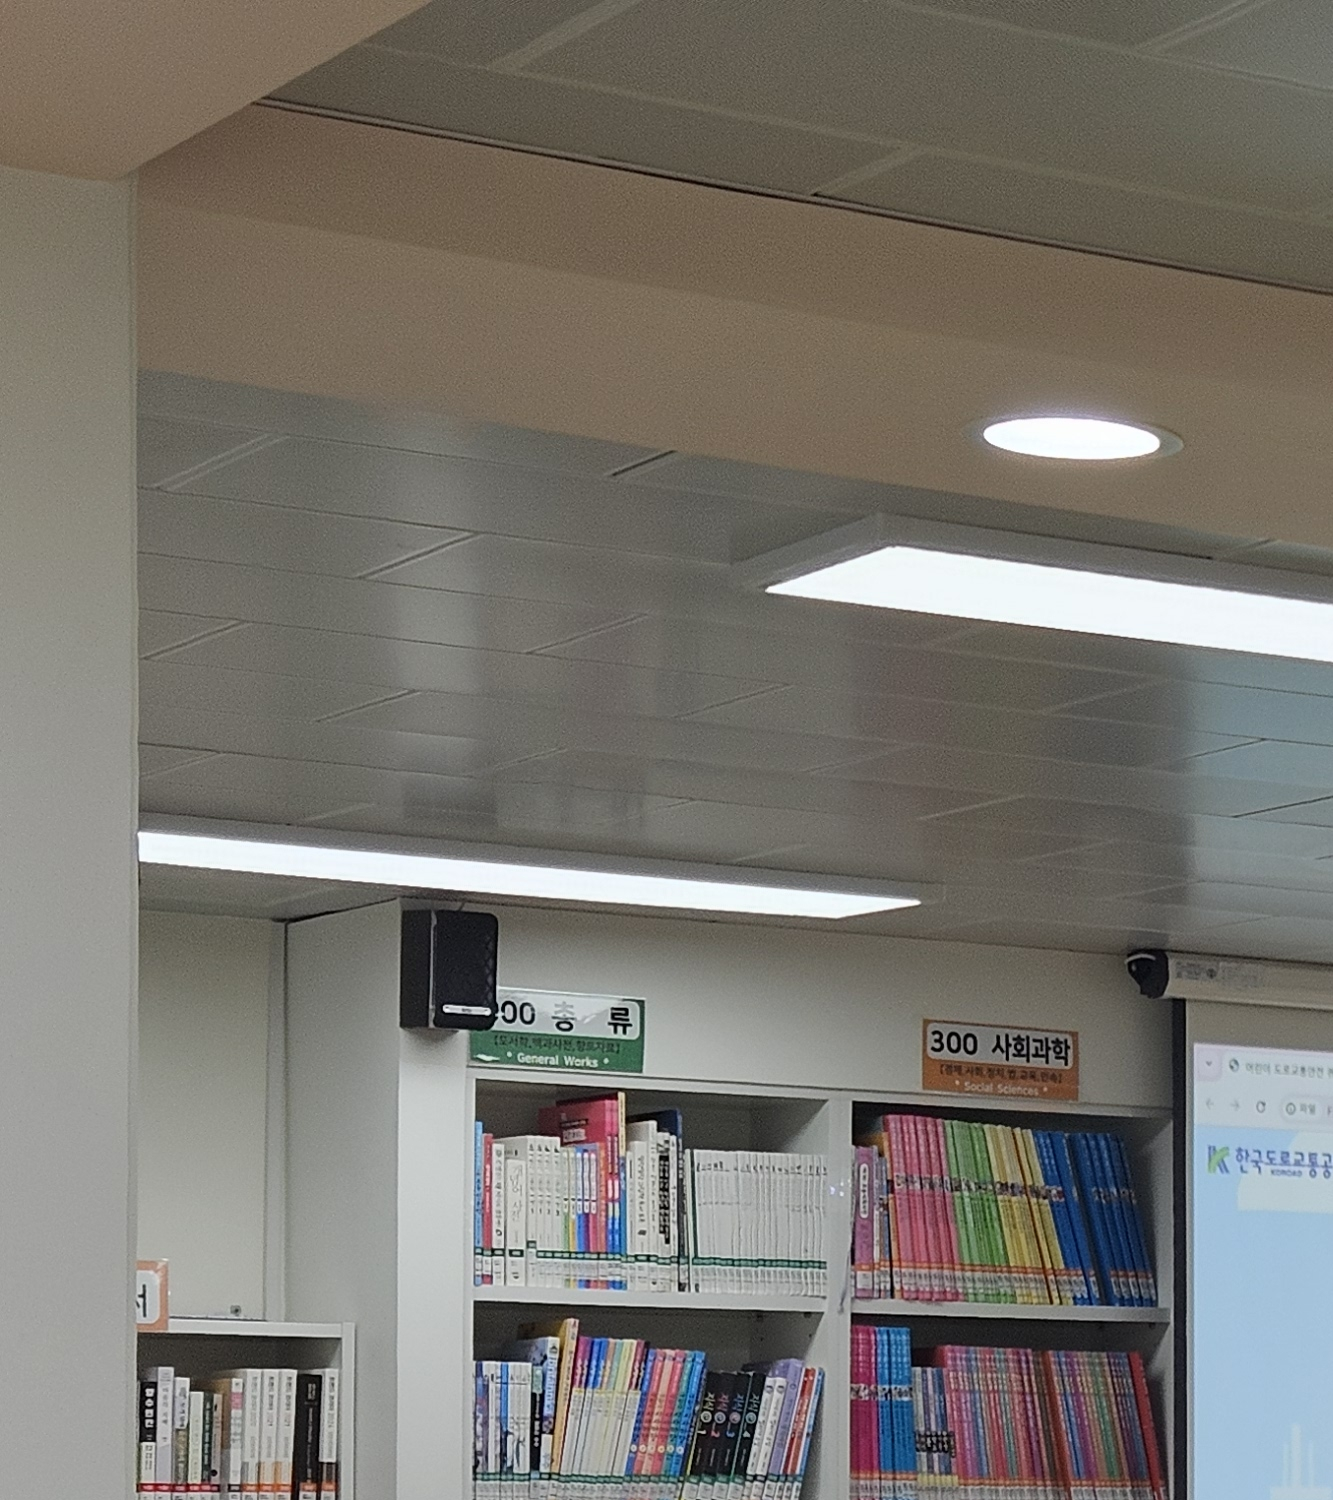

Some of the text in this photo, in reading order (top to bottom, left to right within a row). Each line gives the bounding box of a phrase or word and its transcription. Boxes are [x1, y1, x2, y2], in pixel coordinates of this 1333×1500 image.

[494, 998, 536, 1026] 00
[607, 1006, 634, 1037] 류
[517, 1052, 598, 1068] General Works
[930, 1029, 1071, 1067] 300 사회과학
[963, 1081, 1040, 1097] Social Sciences
